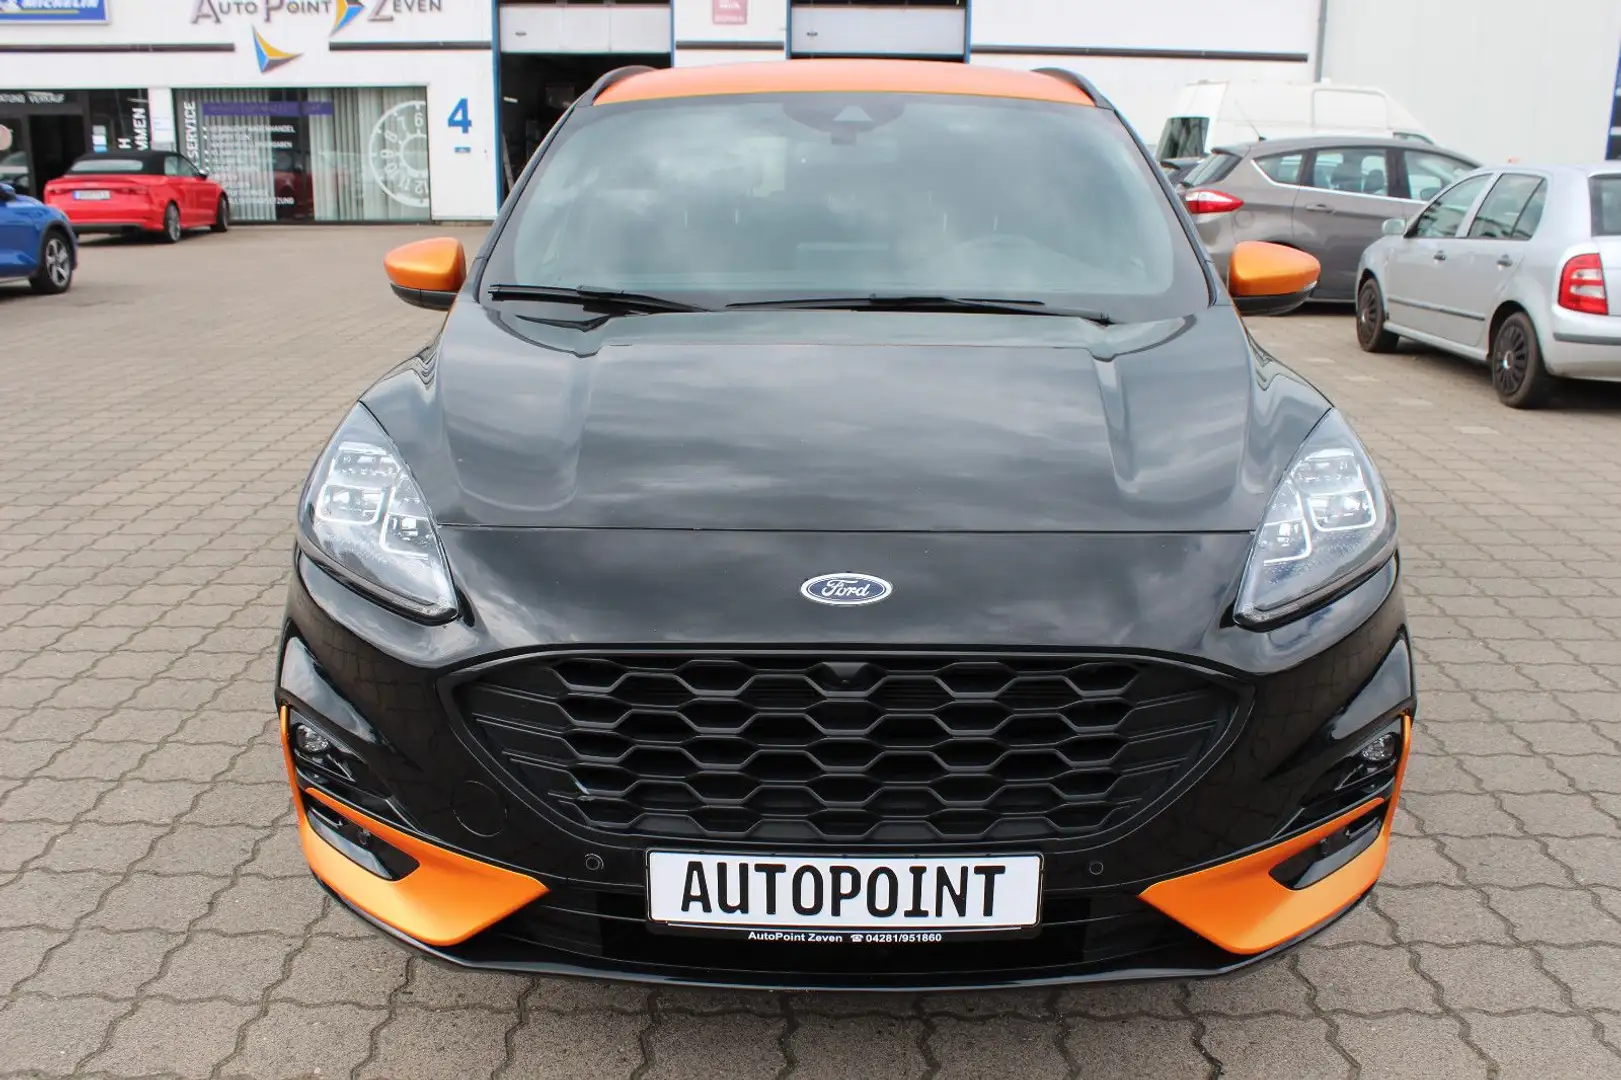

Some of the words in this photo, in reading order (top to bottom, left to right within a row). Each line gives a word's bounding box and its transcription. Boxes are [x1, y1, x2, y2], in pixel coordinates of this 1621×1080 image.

[447, 97, 472, 134] 4
[821, 579, 871, 597] Ford
[680, 860, 1006, 918] AUTOPOINT
[748, 931, 806, 942] AutoPoint
[807, 933, 843, 943] Zeven
[865, 933, 942, 943] 04281/951860
